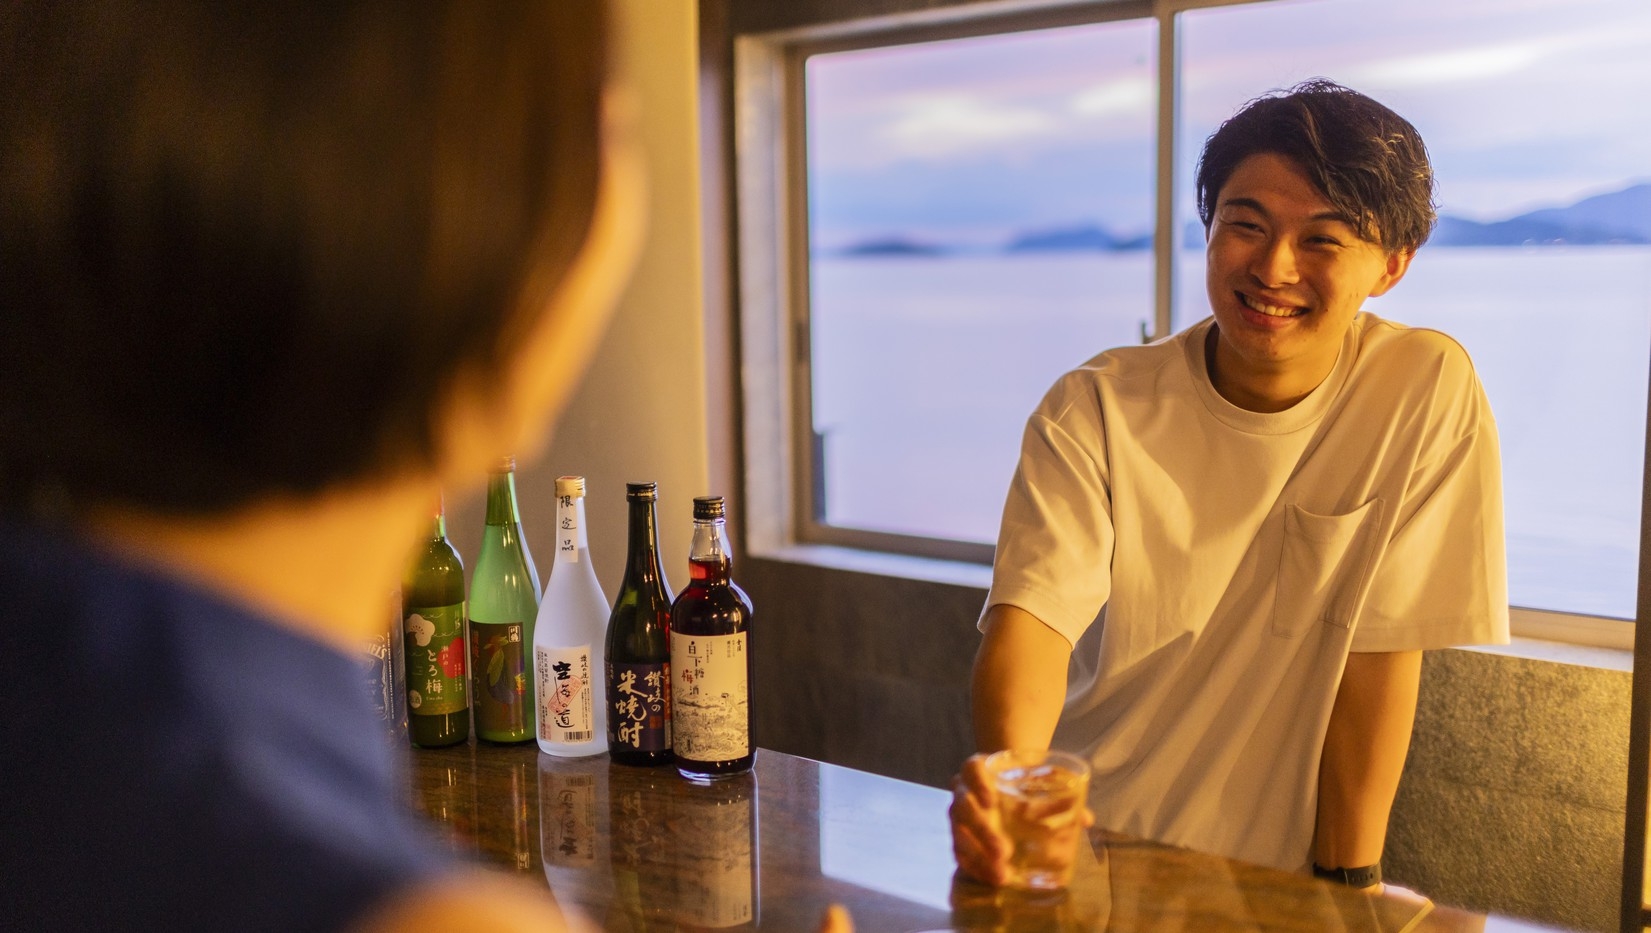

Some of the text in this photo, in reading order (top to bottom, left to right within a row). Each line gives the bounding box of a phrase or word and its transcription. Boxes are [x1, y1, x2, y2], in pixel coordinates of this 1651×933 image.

[560, 495, 576, 551] 限定品
[426, 649, 443, 694] とろ梅
